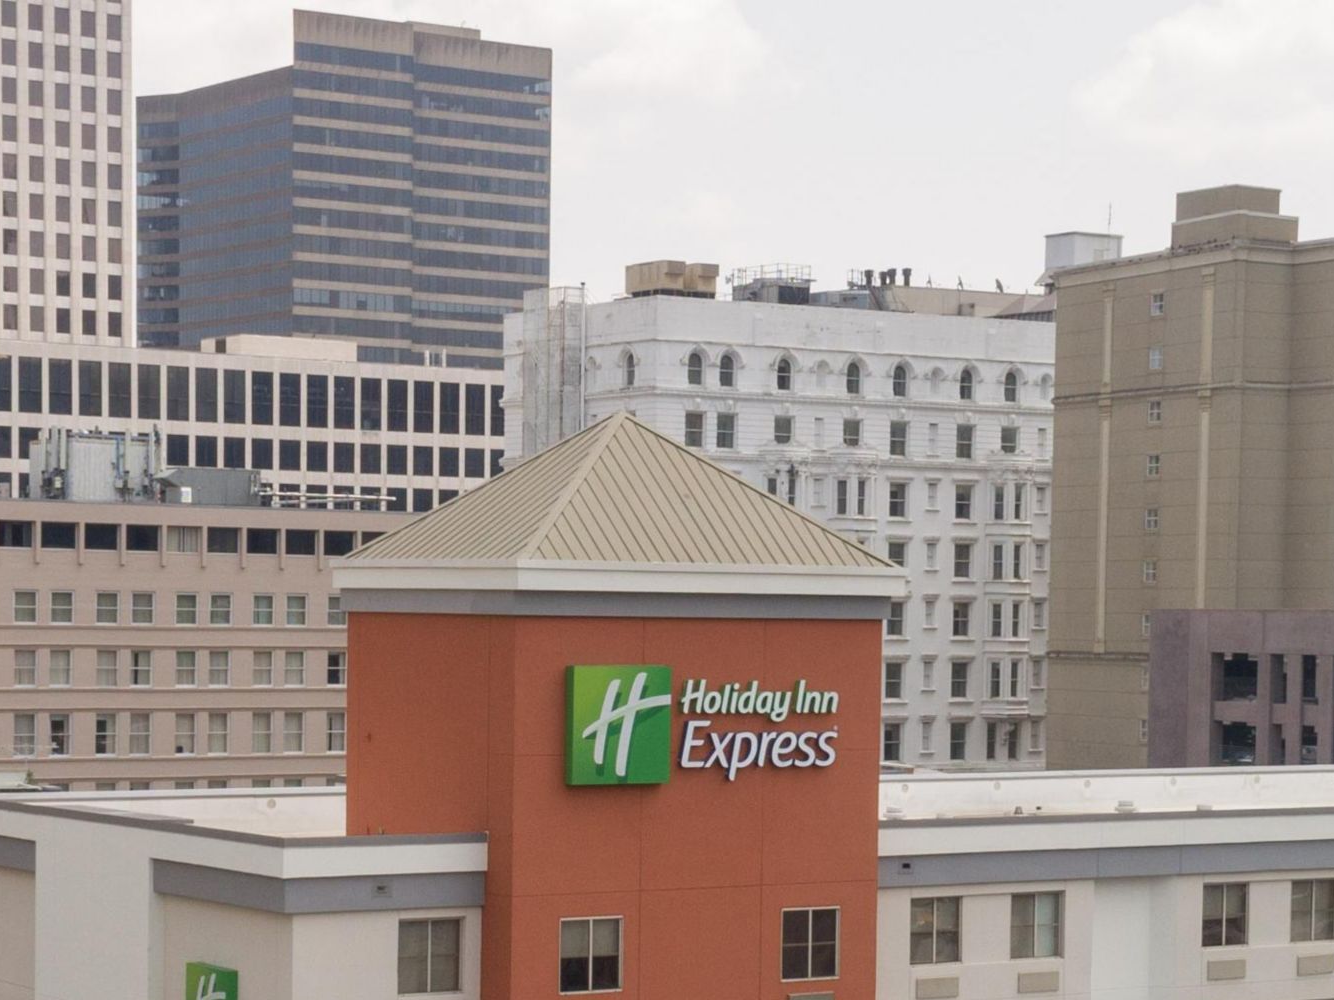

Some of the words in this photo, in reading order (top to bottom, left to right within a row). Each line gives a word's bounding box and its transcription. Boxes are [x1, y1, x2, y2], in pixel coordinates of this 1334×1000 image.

[681, 679, 792, 723] Holiday
[795, 679, 839, 715] Inn
[678, 720, 839, 782] Express
